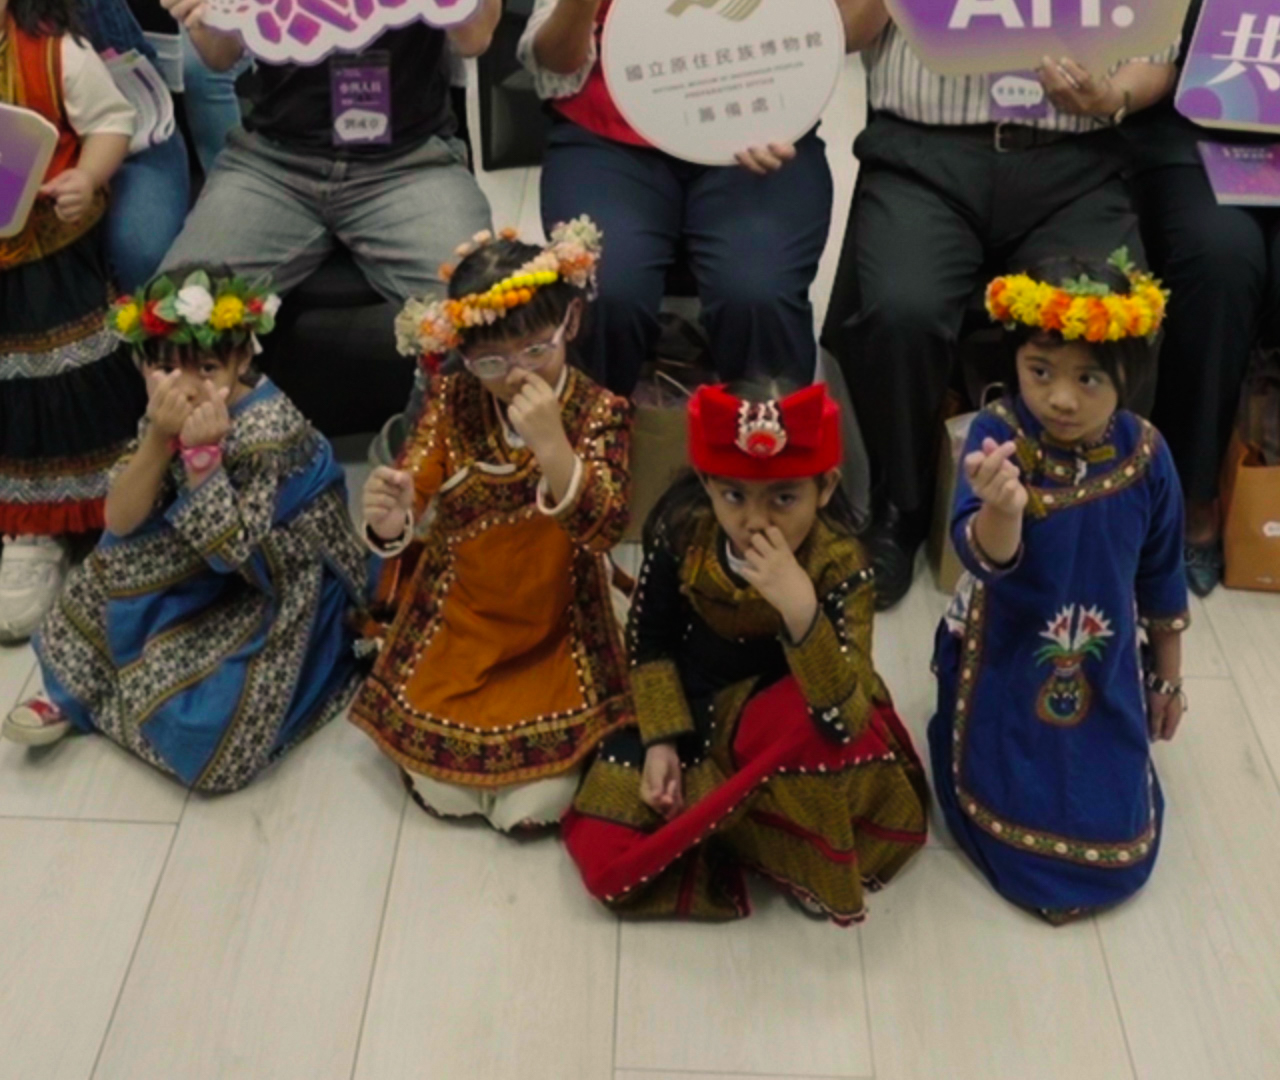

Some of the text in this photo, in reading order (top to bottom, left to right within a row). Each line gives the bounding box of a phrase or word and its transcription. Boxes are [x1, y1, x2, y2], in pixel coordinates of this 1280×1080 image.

[624, 31, 824, 82] 國立原住民族博物館
